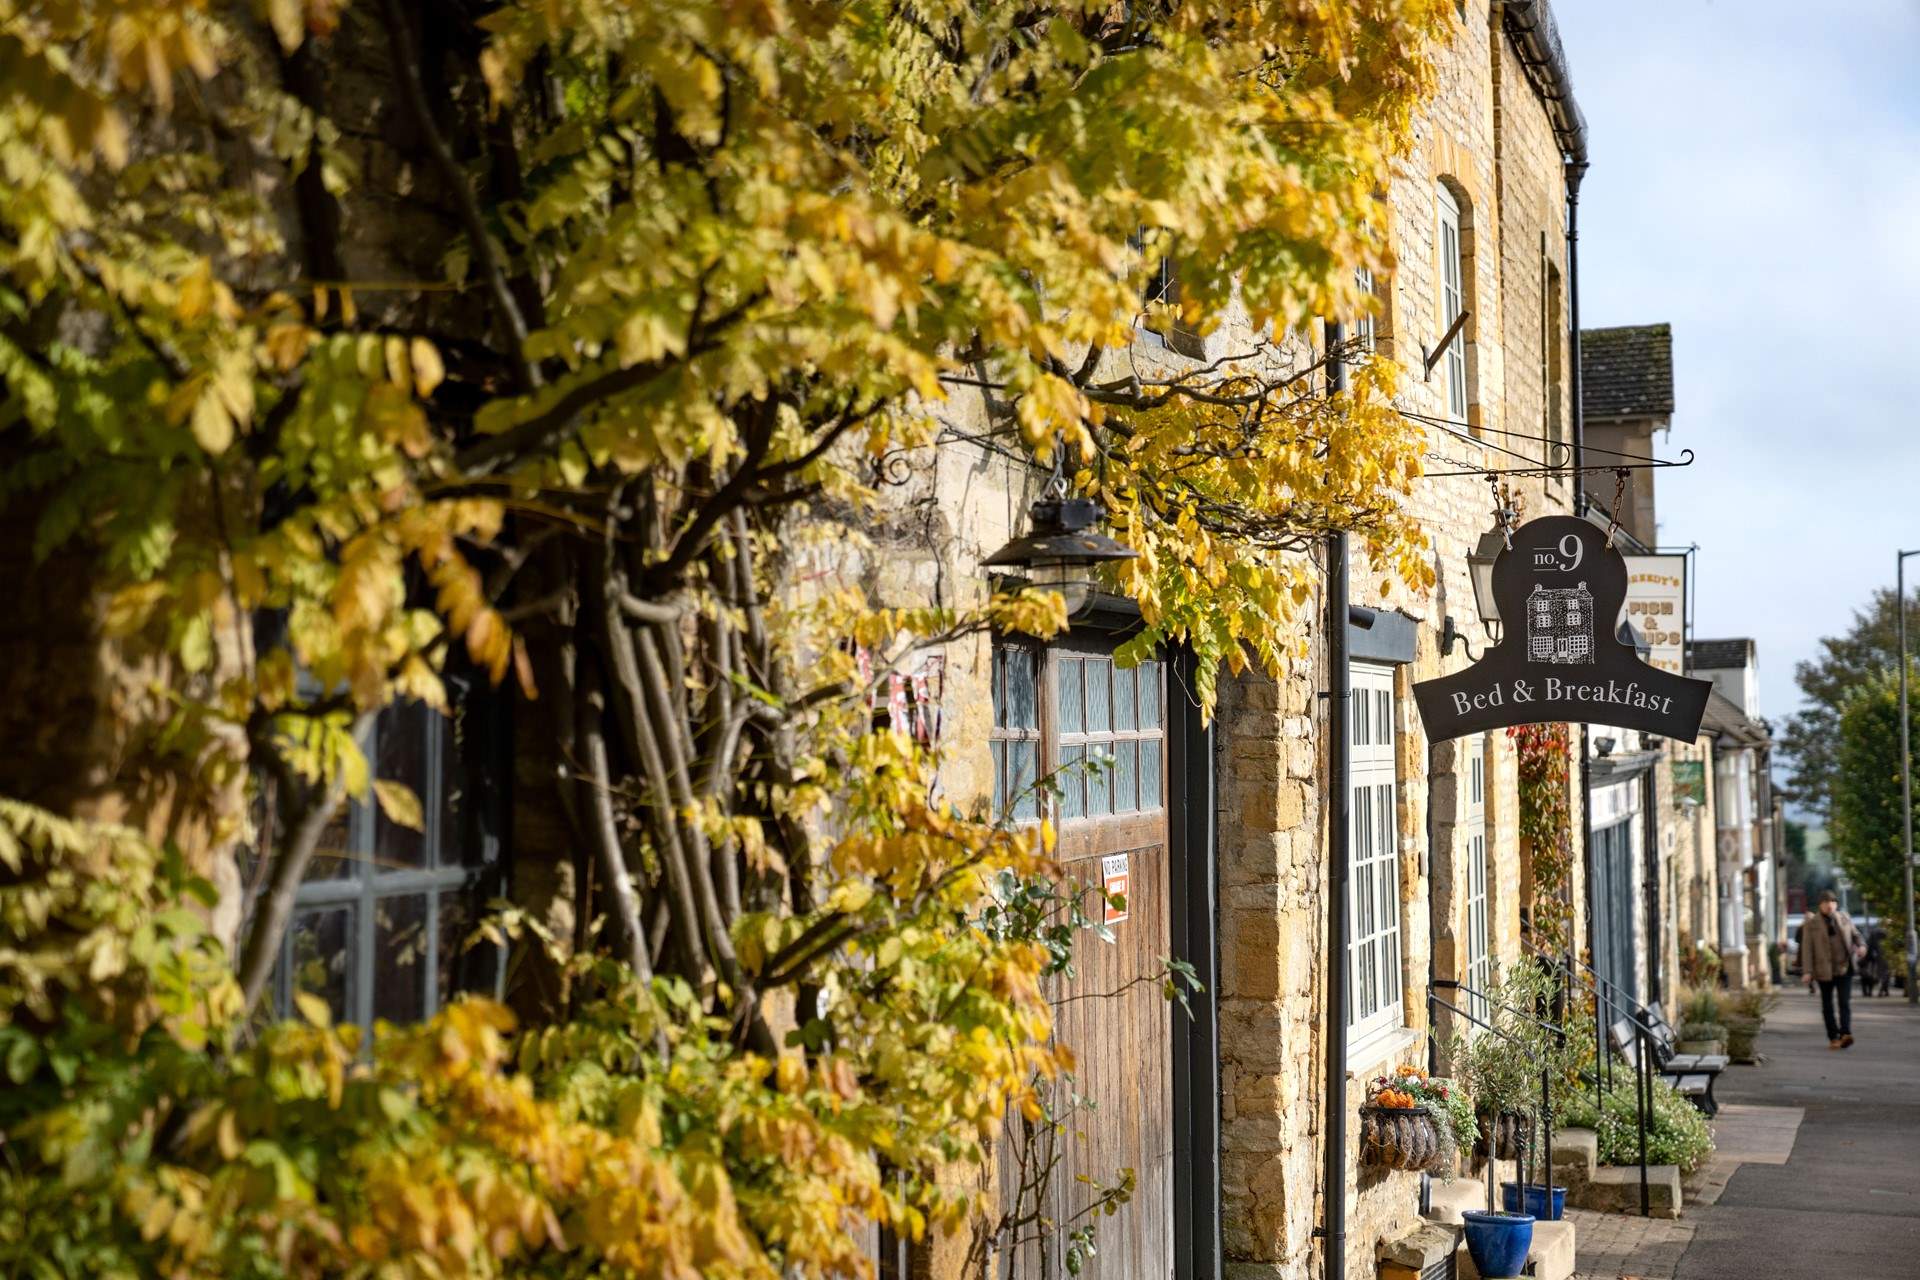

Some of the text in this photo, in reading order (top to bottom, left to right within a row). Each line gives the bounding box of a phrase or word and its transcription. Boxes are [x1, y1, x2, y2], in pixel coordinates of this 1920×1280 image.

[1628, 573, 1680, 587] REEDY'S
[1629, 601, 1674, 616] FISH
[1643, 616, 1658, 630] &
[1642, 631, 1681, 646] IPS
[1449, 677, 1674, 716] Bed & Breakfast
